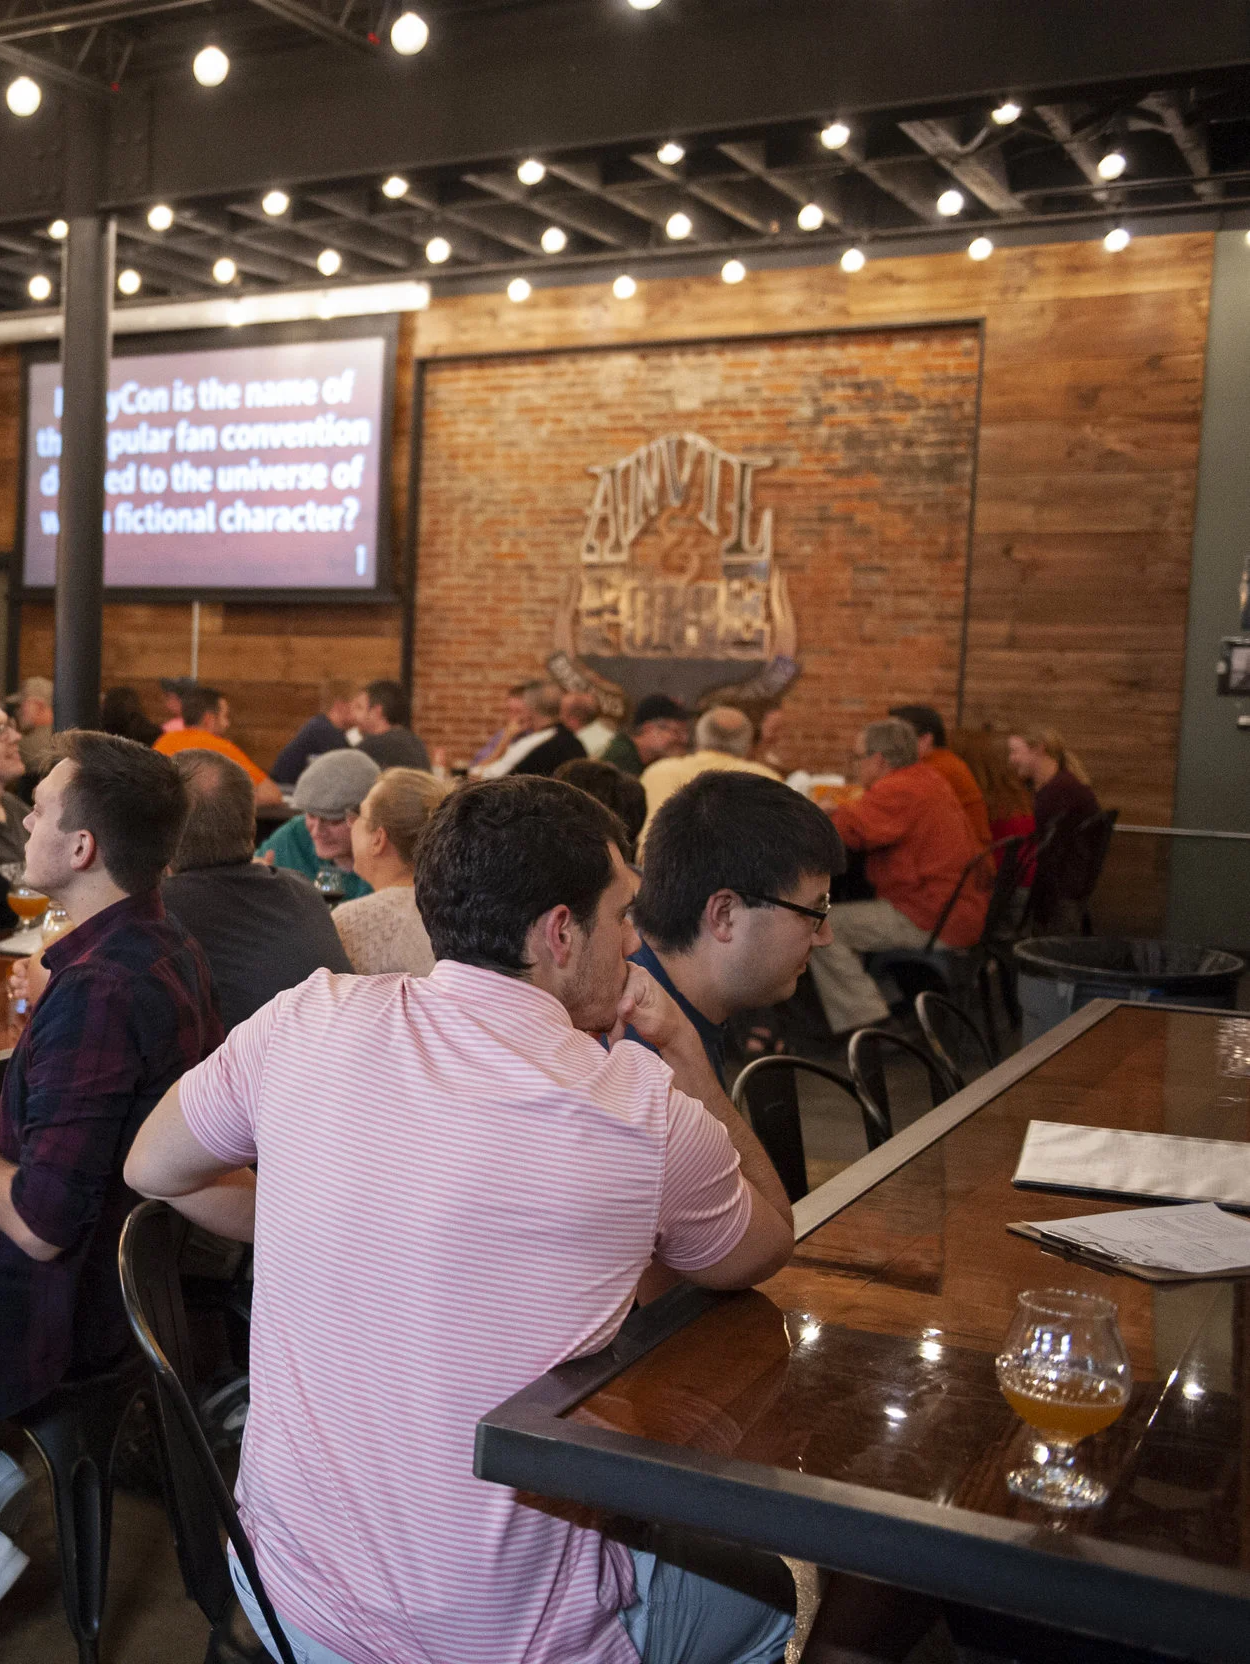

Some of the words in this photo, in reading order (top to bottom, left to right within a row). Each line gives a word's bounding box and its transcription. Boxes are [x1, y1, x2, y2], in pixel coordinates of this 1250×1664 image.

[172, 378, 194, 412] is
[197, 376, 242, 410] the
[244, 376, 318, 408] name
[321, 367, 356, 404] of
[107, 420, 174, 462] pular
[176, 416, 217, 453] fan
[219, 411, 372, 450] convention
[138, 463, 168, 494] to
[170, 459, 214, 494] the
[215, 457, 330, 492] universe
[331, 453, 366, 490] of
[114, 498, 217, 535] fictional
[218, 494, 361, 534] character?
